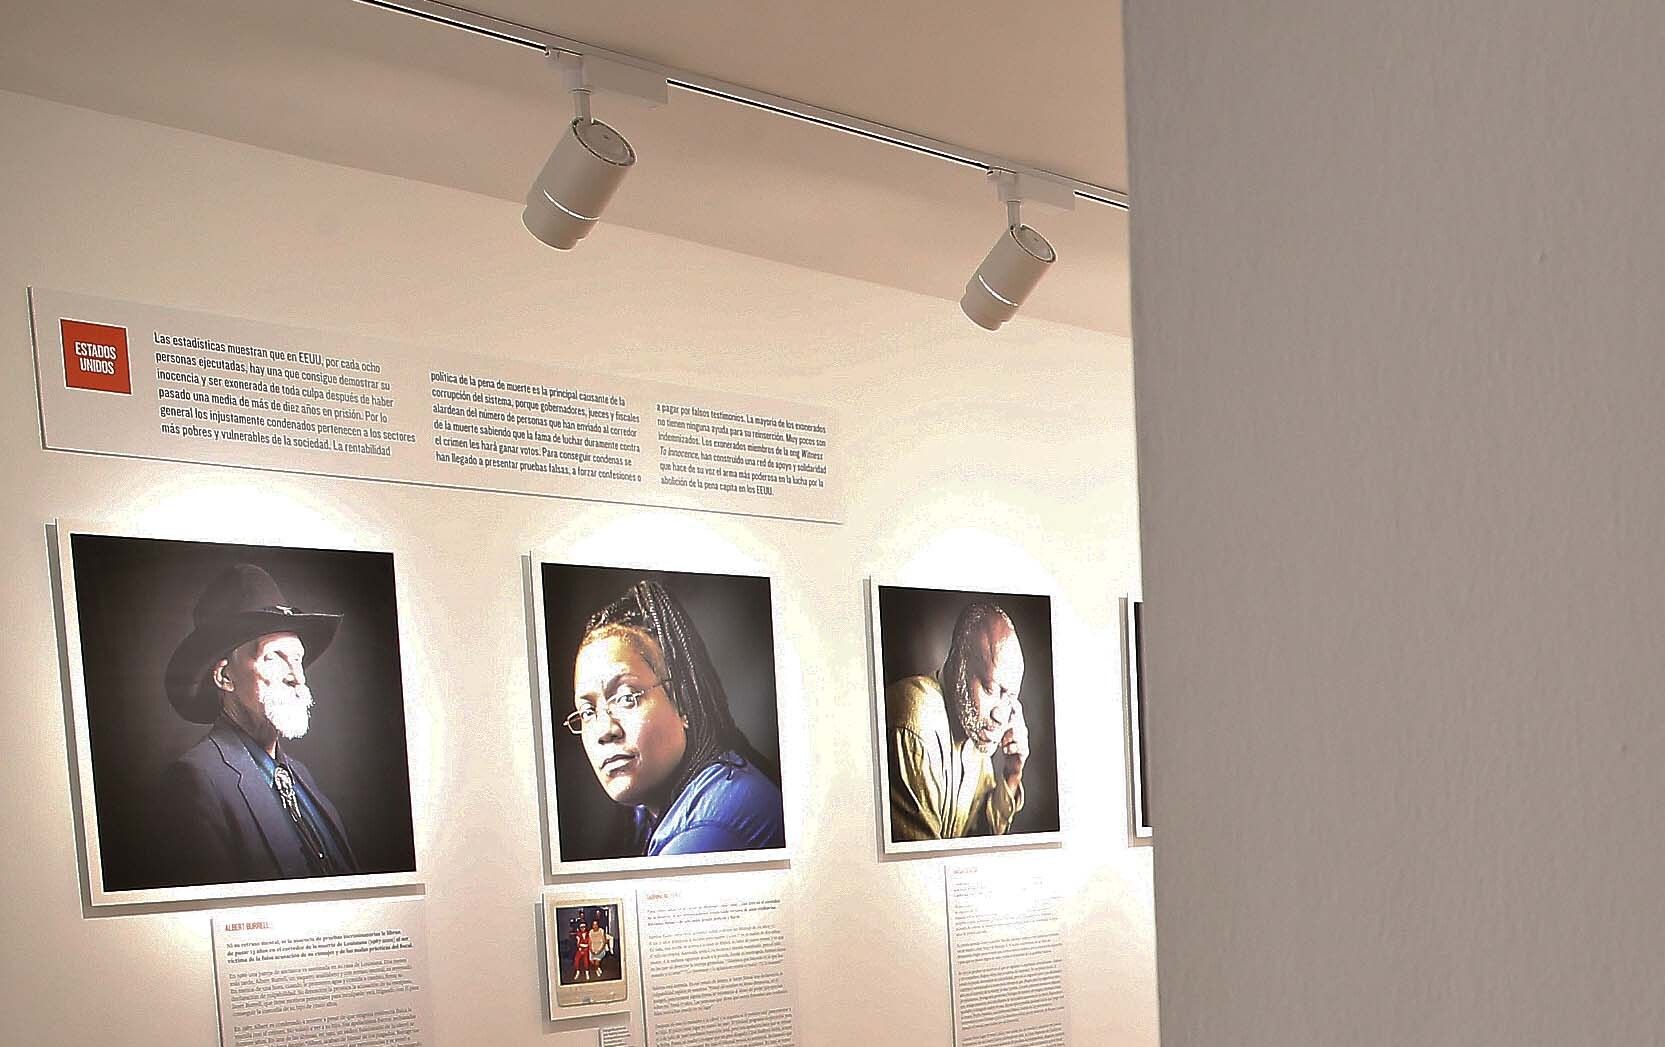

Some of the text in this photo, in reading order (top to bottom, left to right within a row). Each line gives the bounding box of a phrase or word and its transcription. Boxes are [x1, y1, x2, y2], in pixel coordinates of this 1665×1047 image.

[75, 341, 117, 360] ESTADOS
[79, 357, 116, 375] UNIDOS
[154, 332, 171, 344] Las
[228, 345, 268, 357] muestran
[270, 350, 286, 361] que
[287, 353, 297, 361] en
[326, 358, 339, 369] por
[341, 358, 360, 370] cada
[362, 361, 381, 373] ocho
[156, 353, 390, 390] personas ejecutadas, hay una que consigue demostrar su
[157, 368, 394, 407] inocencia y ser exonerada de toda culpa después de haber
[159, 388, 191, 400] pasado
[193, 393, 210, 402] una
[212, 393, 237, 405] media
[240, 395, 250, 407] de
[252, 398, 269, 409] más
[271, 399, 281, 410] de
[283, 400, 300, 413] diez
[301, 403, 321, 415] años
[322, 408, 332, 416] en
[366, 410, 379, 422] Por
[380, 412, 388, 423] lo
[160, 407, 416, 442] general los injustamente condenados pertenecen a los sectores
[162, 422, 180, 434] más
[183, 425, 212, 438] pobres
[214, 430, 219, 441] y
[221, 429, 270, 443] vulnerables
[272, 433, 282, 444] de
[284, 434, 292, 446] la
[333, 440, 343, 451] La
